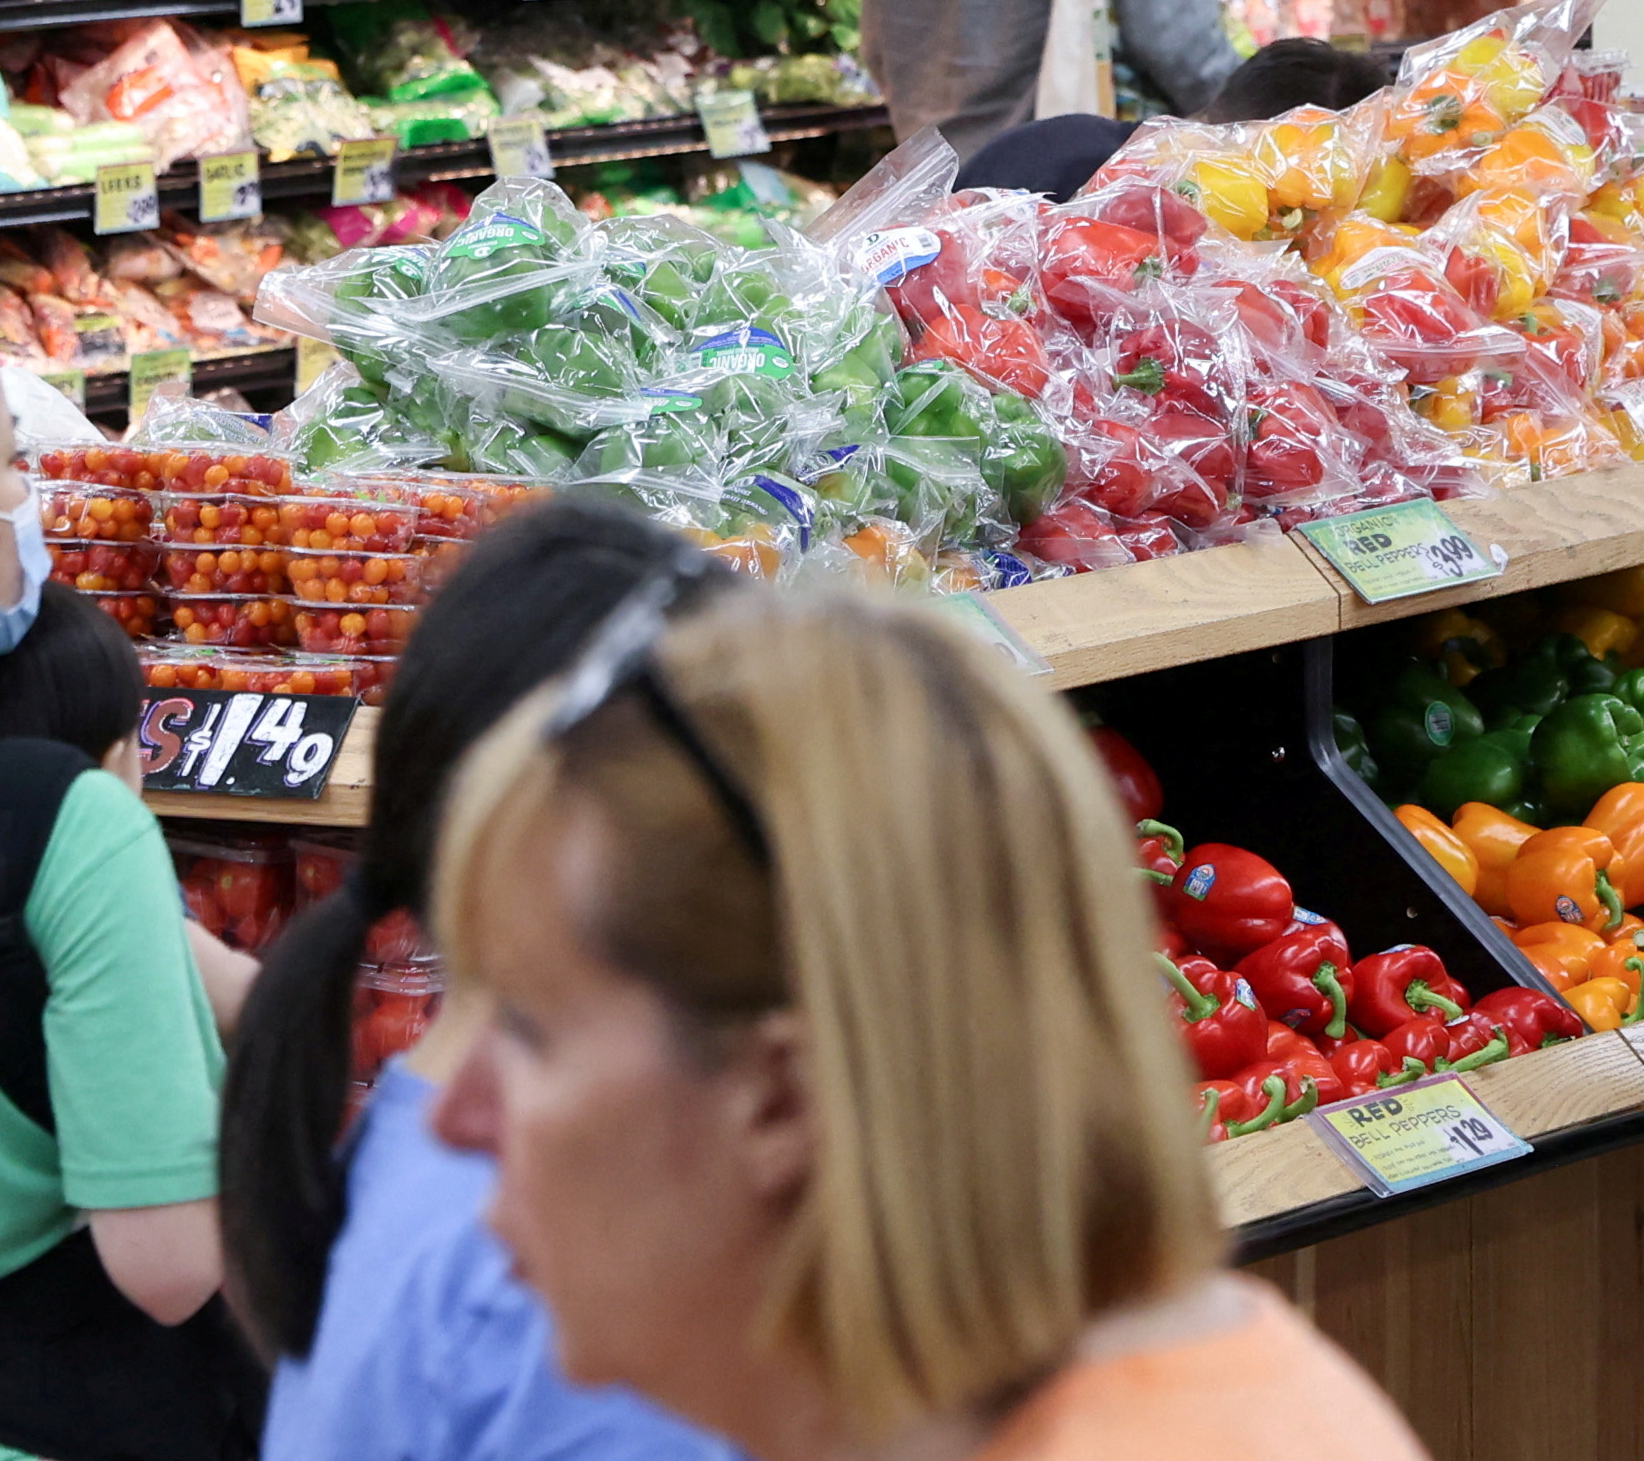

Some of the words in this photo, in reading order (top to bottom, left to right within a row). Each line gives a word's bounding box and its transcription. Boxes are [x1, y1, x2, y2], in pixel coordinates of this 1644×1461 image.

[101, 175, 143, 195] LEEKS
[708, 351, 767, 371] ORGANIC
[1343, 533, 1394, 557] RED
[1344, 554, 1380, 574] BELL
[1377, 542, 1431, 570] PEPPERS
[1347, 1098, 1404, 1128] RED
[1349, 1129, 1391, 1150] BELL
[1389, 1104, 1462, 1136] PEPPERS
